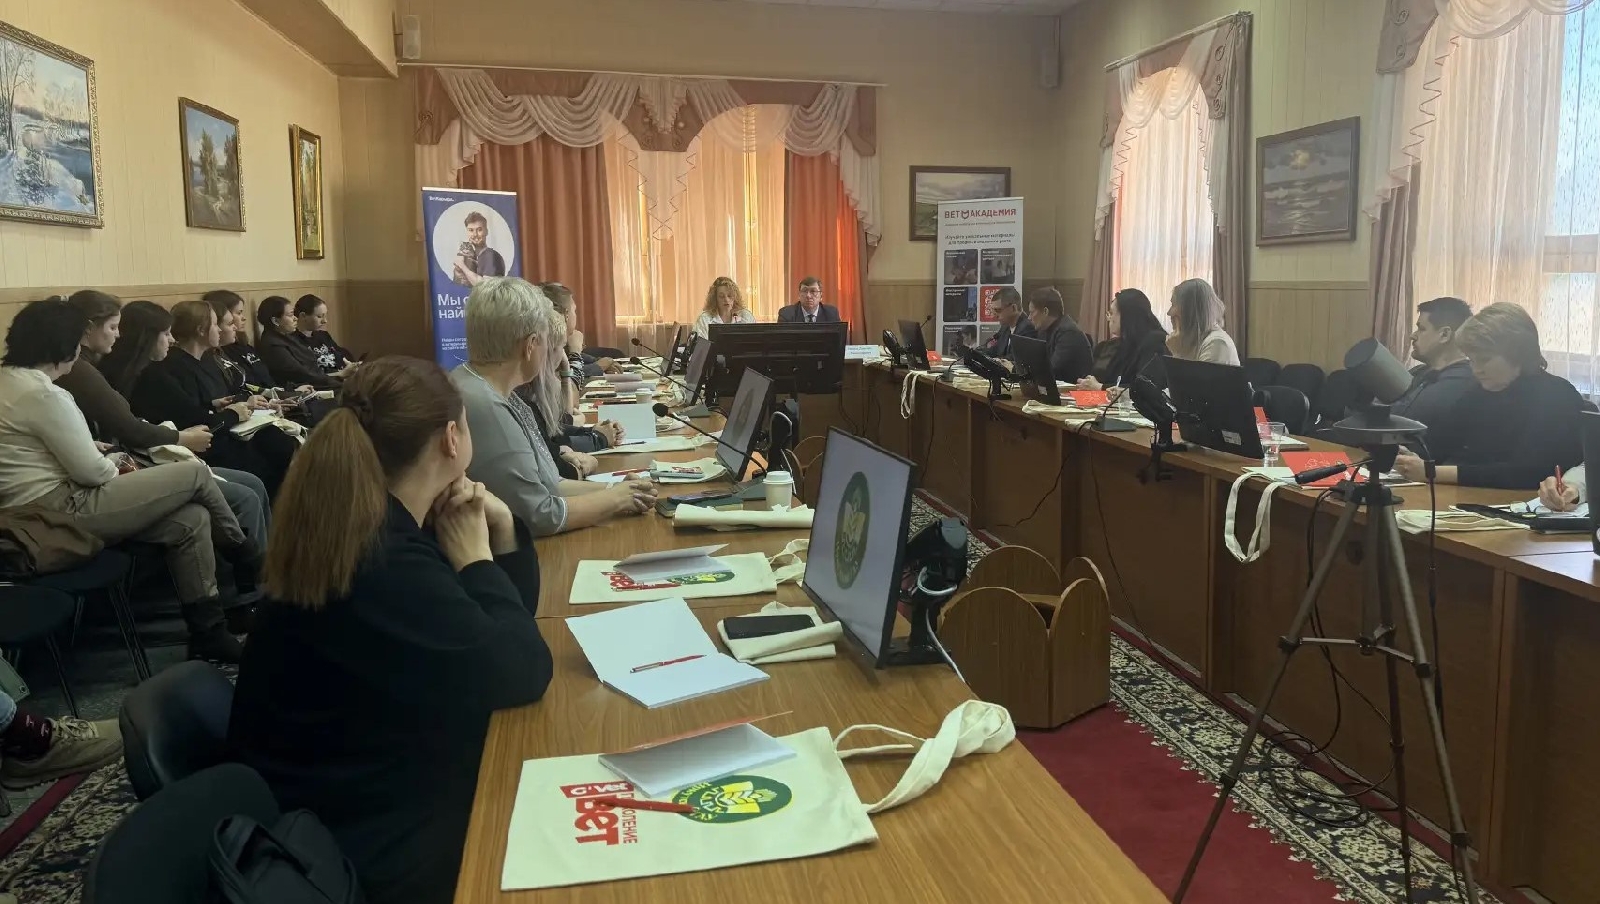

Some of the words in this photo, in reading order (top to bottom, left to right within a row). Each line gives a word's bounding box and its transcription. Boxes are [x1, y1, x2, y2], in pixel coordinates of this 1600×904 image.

[970, 209, 1016, 217] АКАДЕМИЯ
[437, 293, 461, 306] Мы
[438, 306, 466, 319] най
[620, 792, 638, 844] ПОЛЕНИЕ
